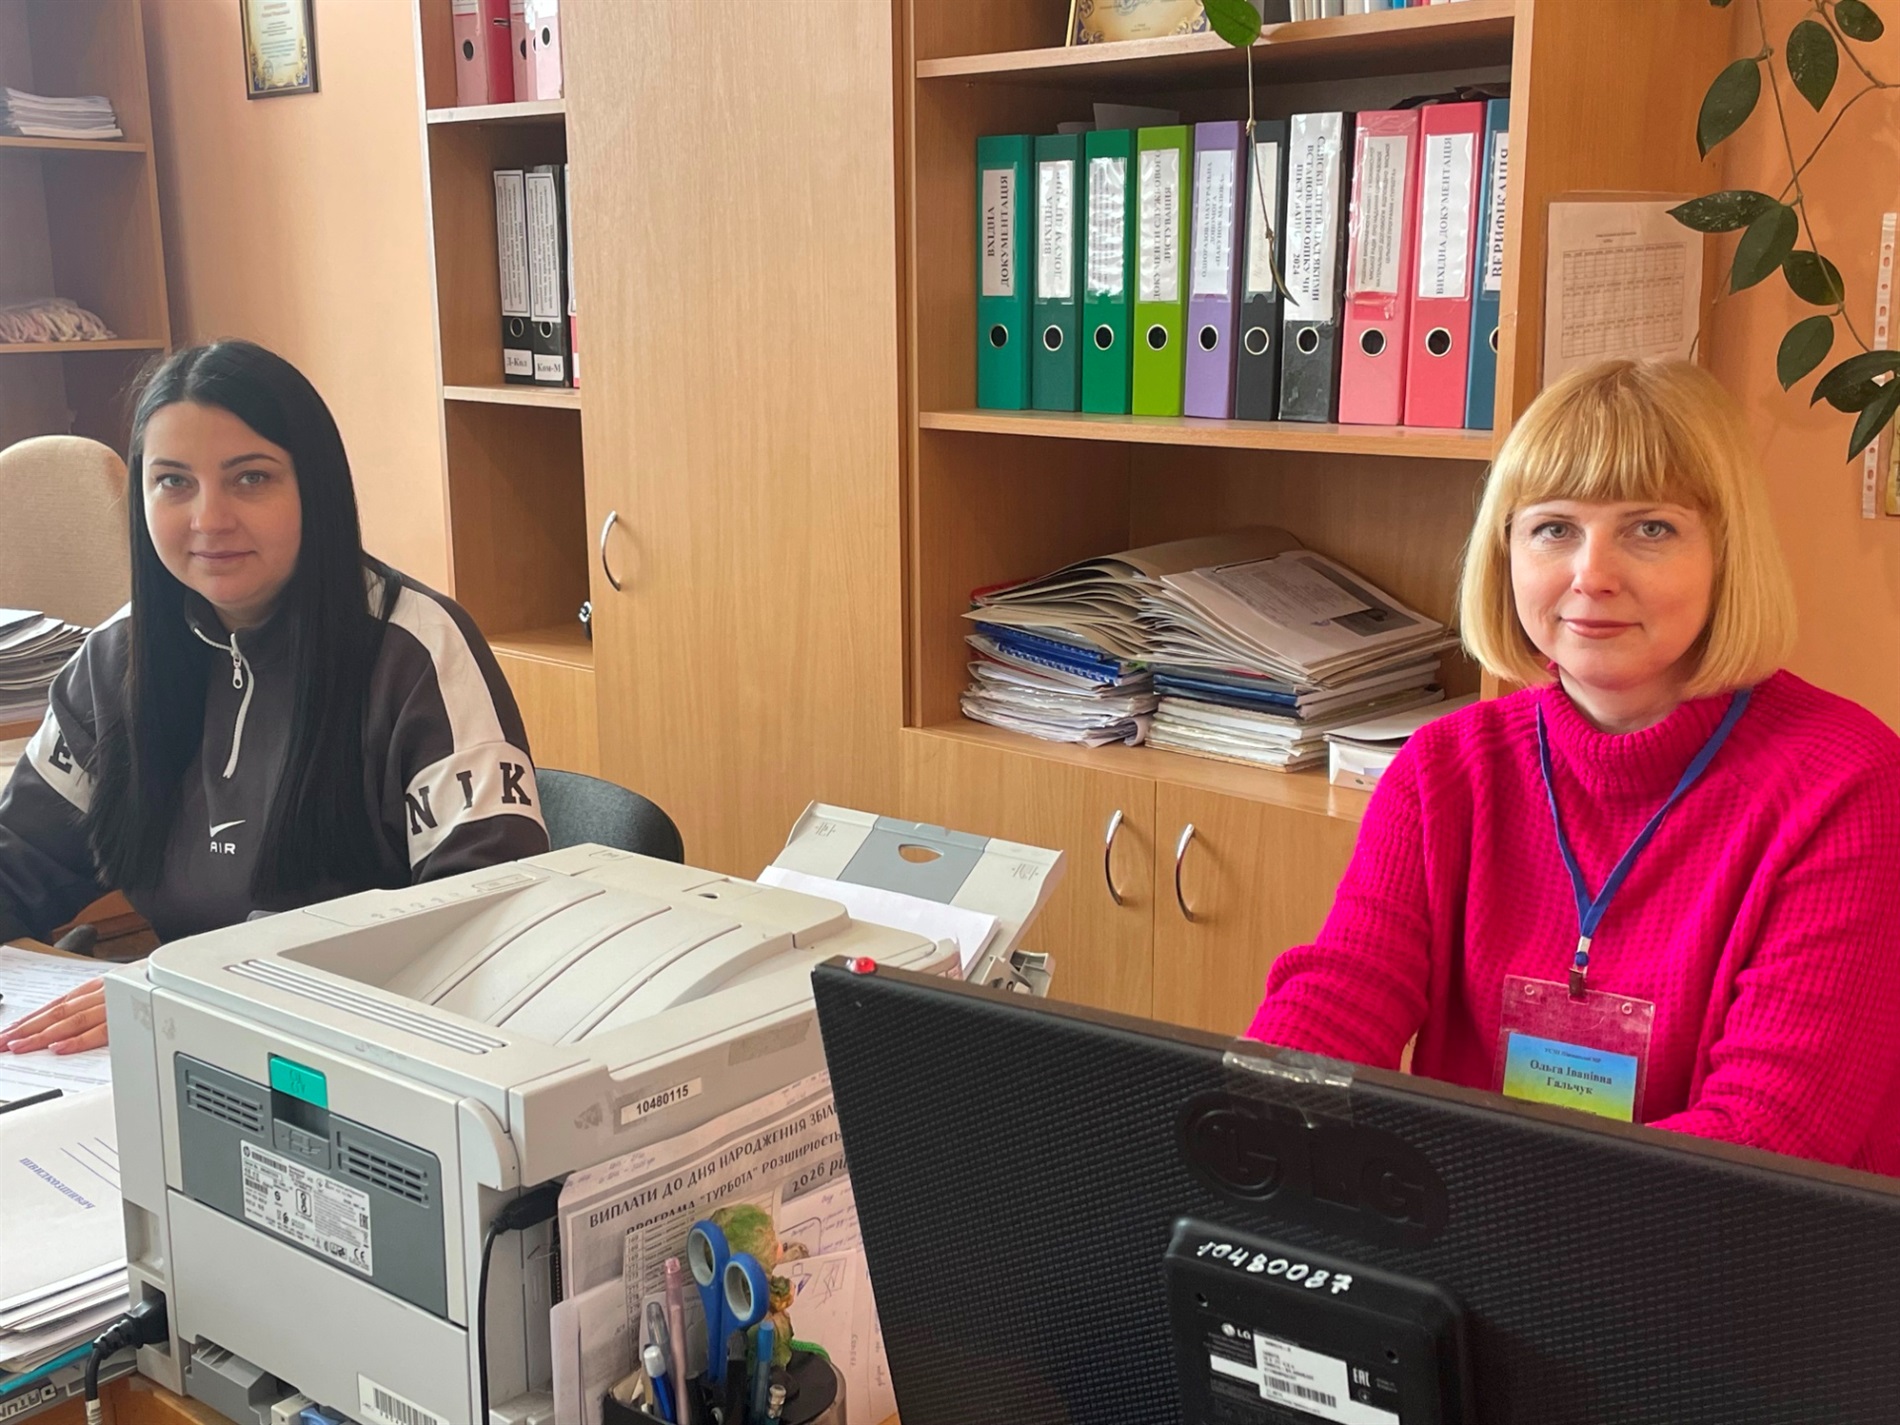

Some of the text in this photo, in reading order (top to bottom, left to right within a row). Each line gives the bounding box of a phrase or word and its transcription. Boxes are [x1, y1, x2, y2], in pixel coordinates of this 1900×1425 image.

[987, 206, 996, 257] ВХІДНА
[1000, 175, 1011, 288] ДОКУМЕНТАЦІЯ
[1163, 186, 1173, 263] ЛИСТУВАННЯ
[1202, 162, 1213, 278] ОДНОРАЗОВА НАТУРАЛЬНА
[1210, 195, 1218, 245] ДОПОМОГА
[1301, 144, 1315, 293] ВСТАНОВЛЕНО ОПІКУ ЧИ
[1436, 137, 1453, 295] ВИХІДНА ДОКУМЕНТАЦІЯ
[1292, 252, 1300, 276] 2024
[1311, 258, 1321, 302] ЯКИМИ
[210, 841, 236, 855] AIR
[1530, 1059, 1613, 1085] Ольга Іванівна
[1547, 1077, 1593, 1095] Гальчук
[636, 1085, 689, 1115] 10480115
[590, 1187, 658, 1228] ВИПЛАТИ
[662, 1178, 683, 1199] ДО
[687, 1165, 716, 1188] ДНЯ
[720, 1117, 807, 1168] НАРОДЖЕННЯ
[792, 1162, 825, 1193] 2026
[1237, 1328, 1251, 1340] LG
